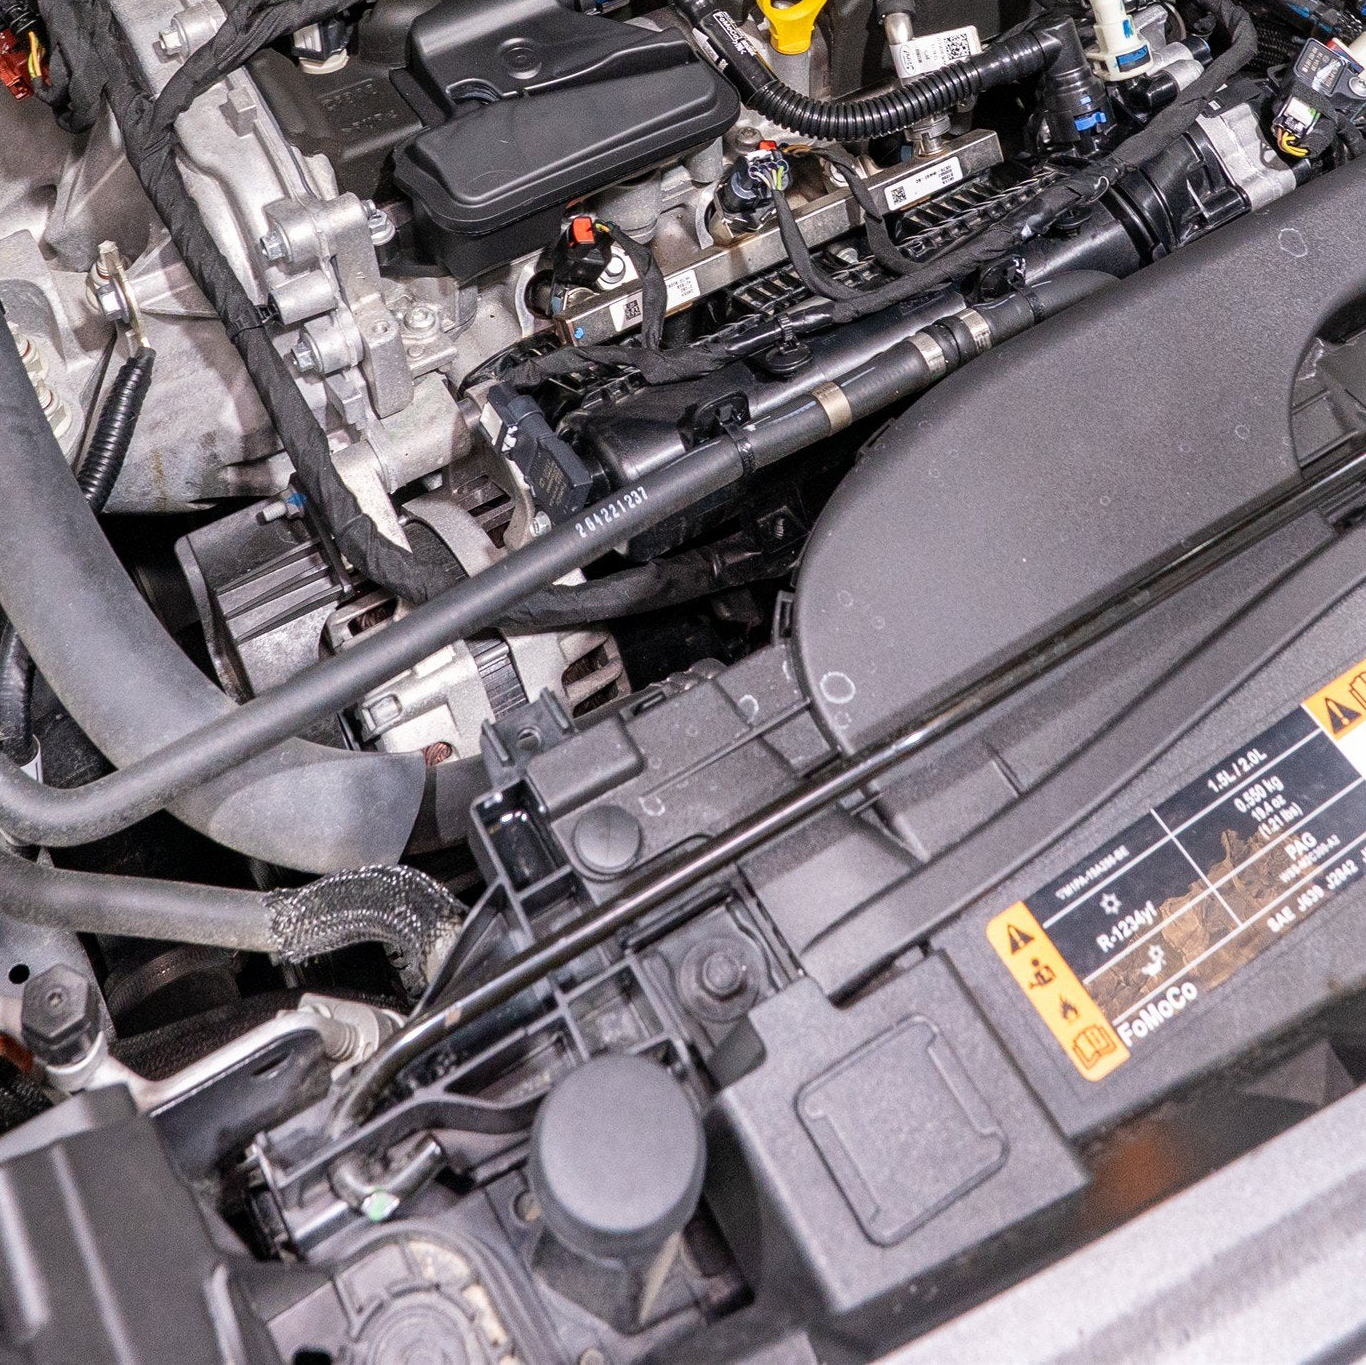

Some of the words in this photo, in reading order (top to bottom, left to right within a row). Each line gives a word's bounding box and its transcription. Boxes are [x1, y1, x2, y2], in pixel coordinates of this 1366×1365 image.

[1207, 769, 1236, 793] 1.5L
[1238, 748, 1268, 773] 2.0L
[1234, 783, 1267, 813] 0.550
[1265, 775, 1284, 795] kg
[1271, 794, 1287, 809] oz
[1258, 815, 1285, 840] (1.21
[1279, 802, 1304, 824] lbs)
[1284, 832, 1318, 861] PAG
[1096, 900, 1158, 952] R-1234yf
[1266, 905, 1296, 933] SAE
[1117, 982, 1198, 1047] FoMoCo
